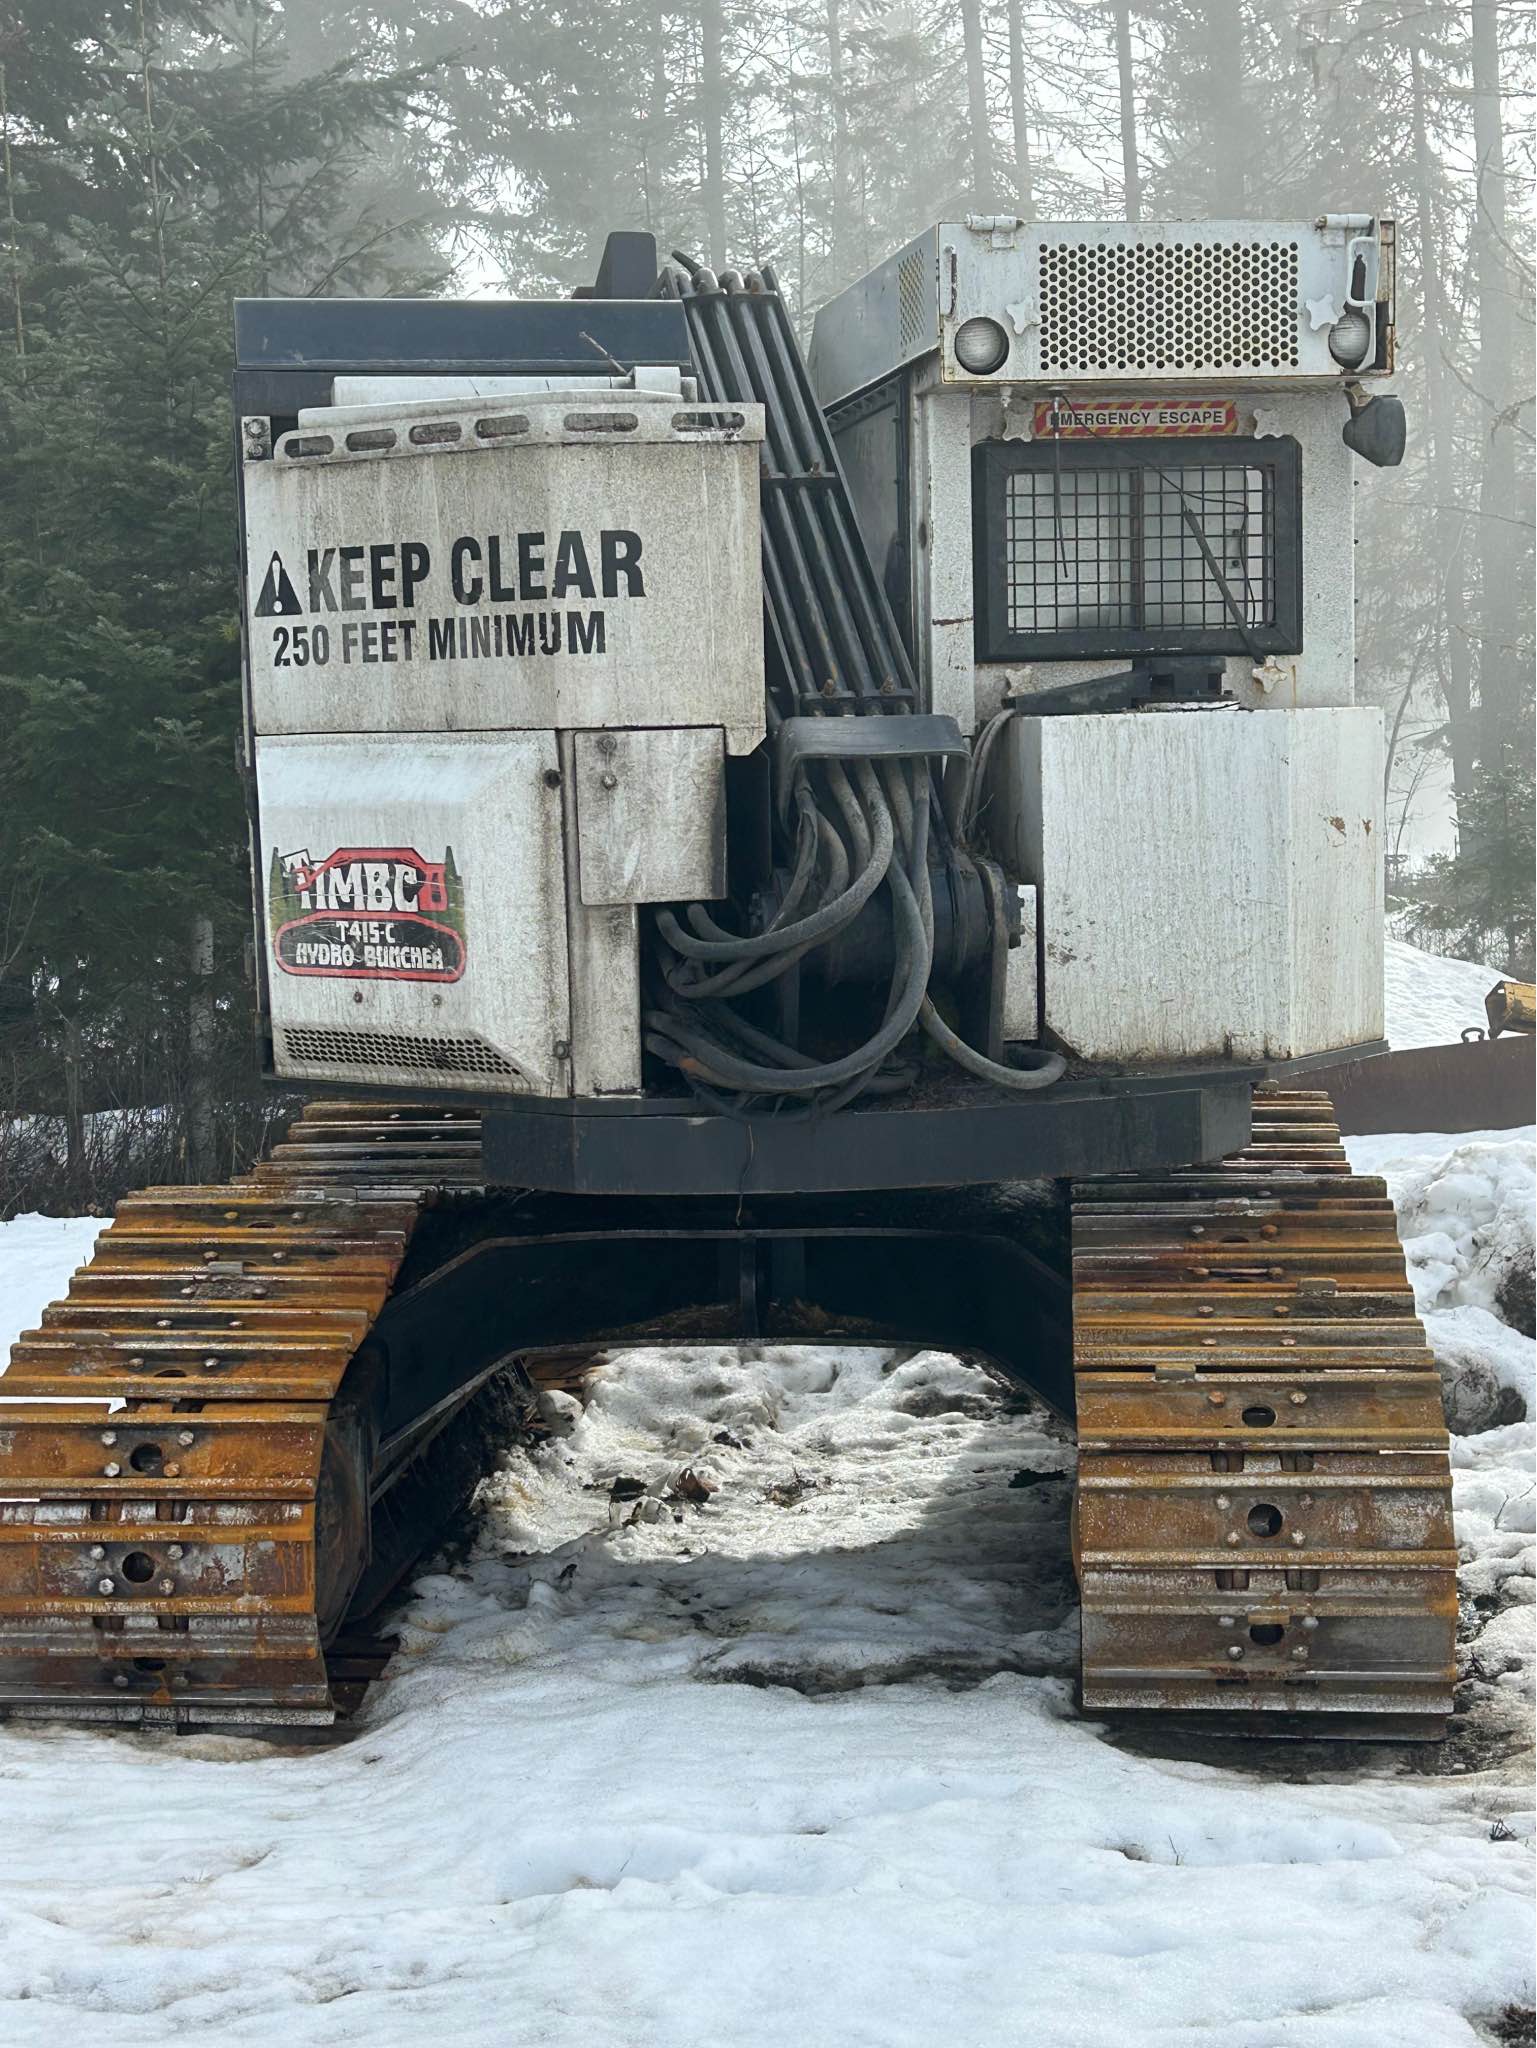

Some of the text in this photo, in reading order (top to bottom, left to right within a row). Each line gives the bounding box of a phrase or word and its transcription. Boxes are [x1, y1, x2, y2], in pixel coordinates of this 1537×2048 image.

[1159, 410, 1223, 425] ESCAPE
[307, 530, 648, 613] KEEP CLEAR
[272, 610, 607, 667] 250 FEET MINIMUM
[336, 920, 396, 944] T415-C
[296, 943, 444, 970] HYDRO BUNCHER
